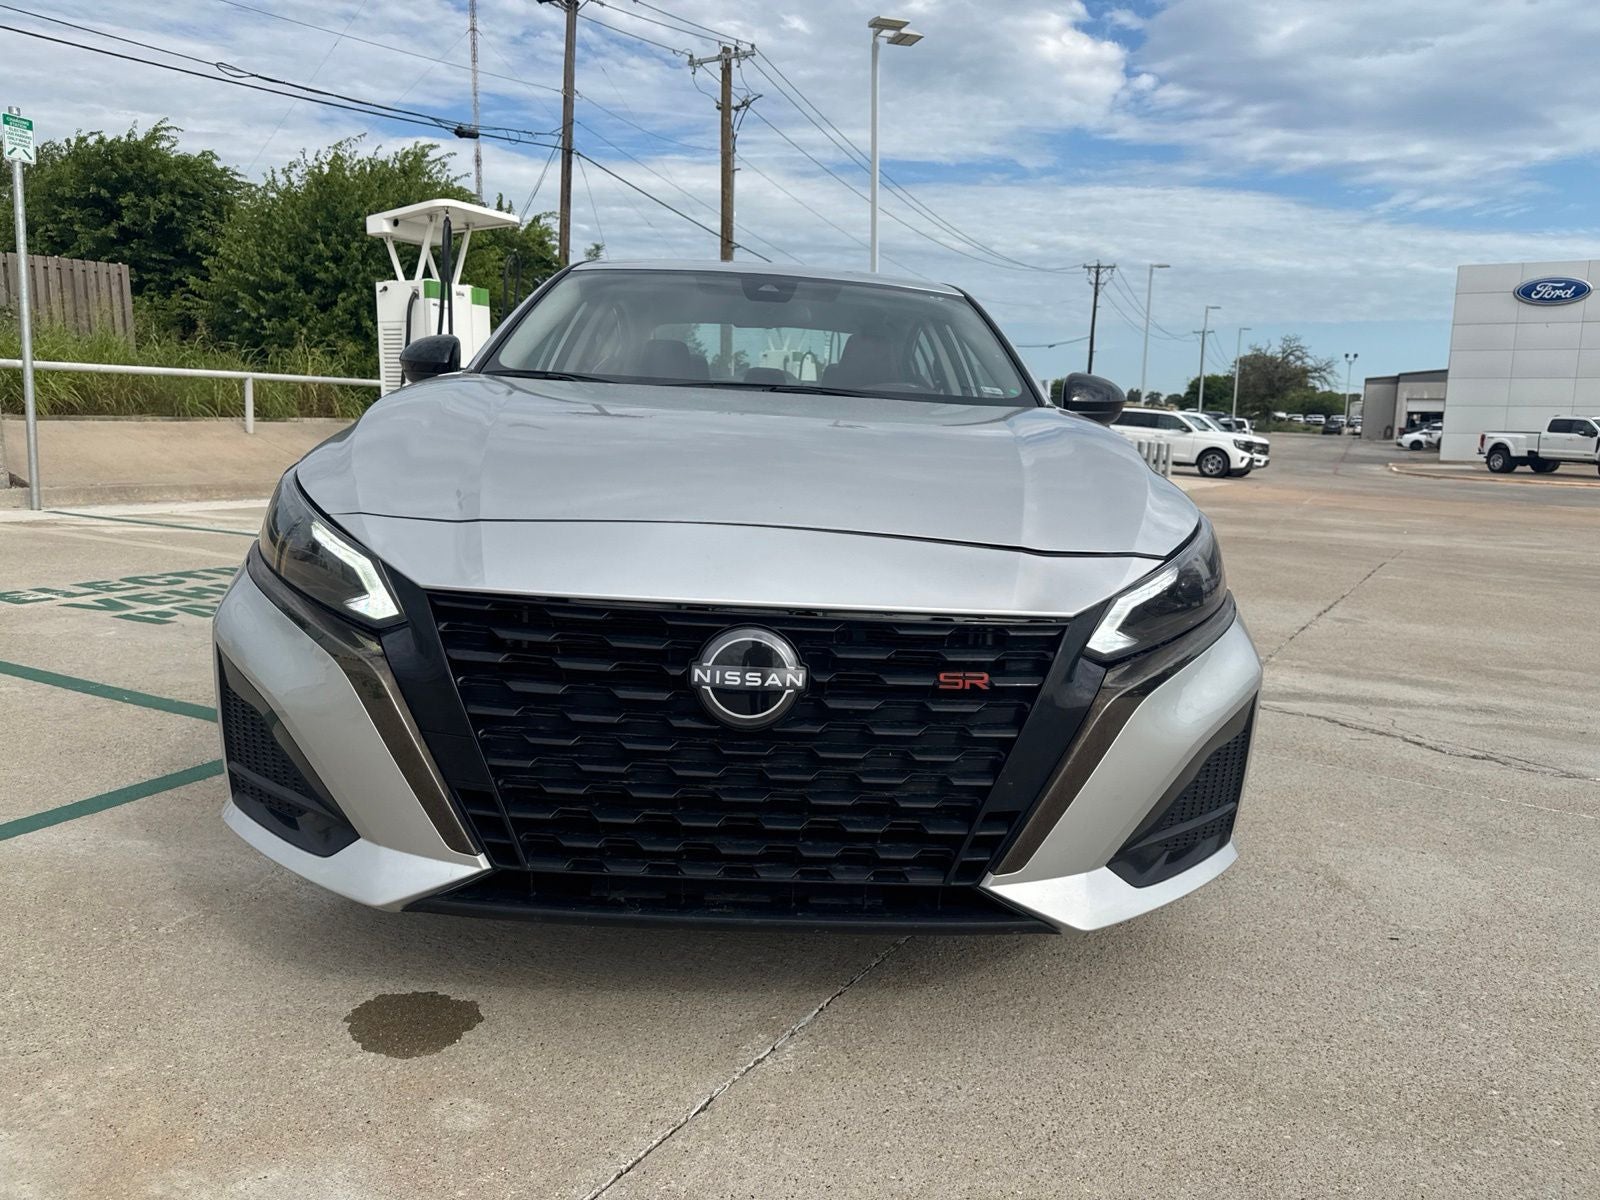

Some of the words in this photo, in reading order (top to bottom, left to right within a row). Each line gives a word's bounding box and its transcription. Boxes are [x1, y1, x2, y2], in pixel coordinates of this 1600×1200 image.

[1531, 282, 1576, 299] Ford
[692, 668, 804, 688] NISSAN
[937, 671, 991, 690] SR
